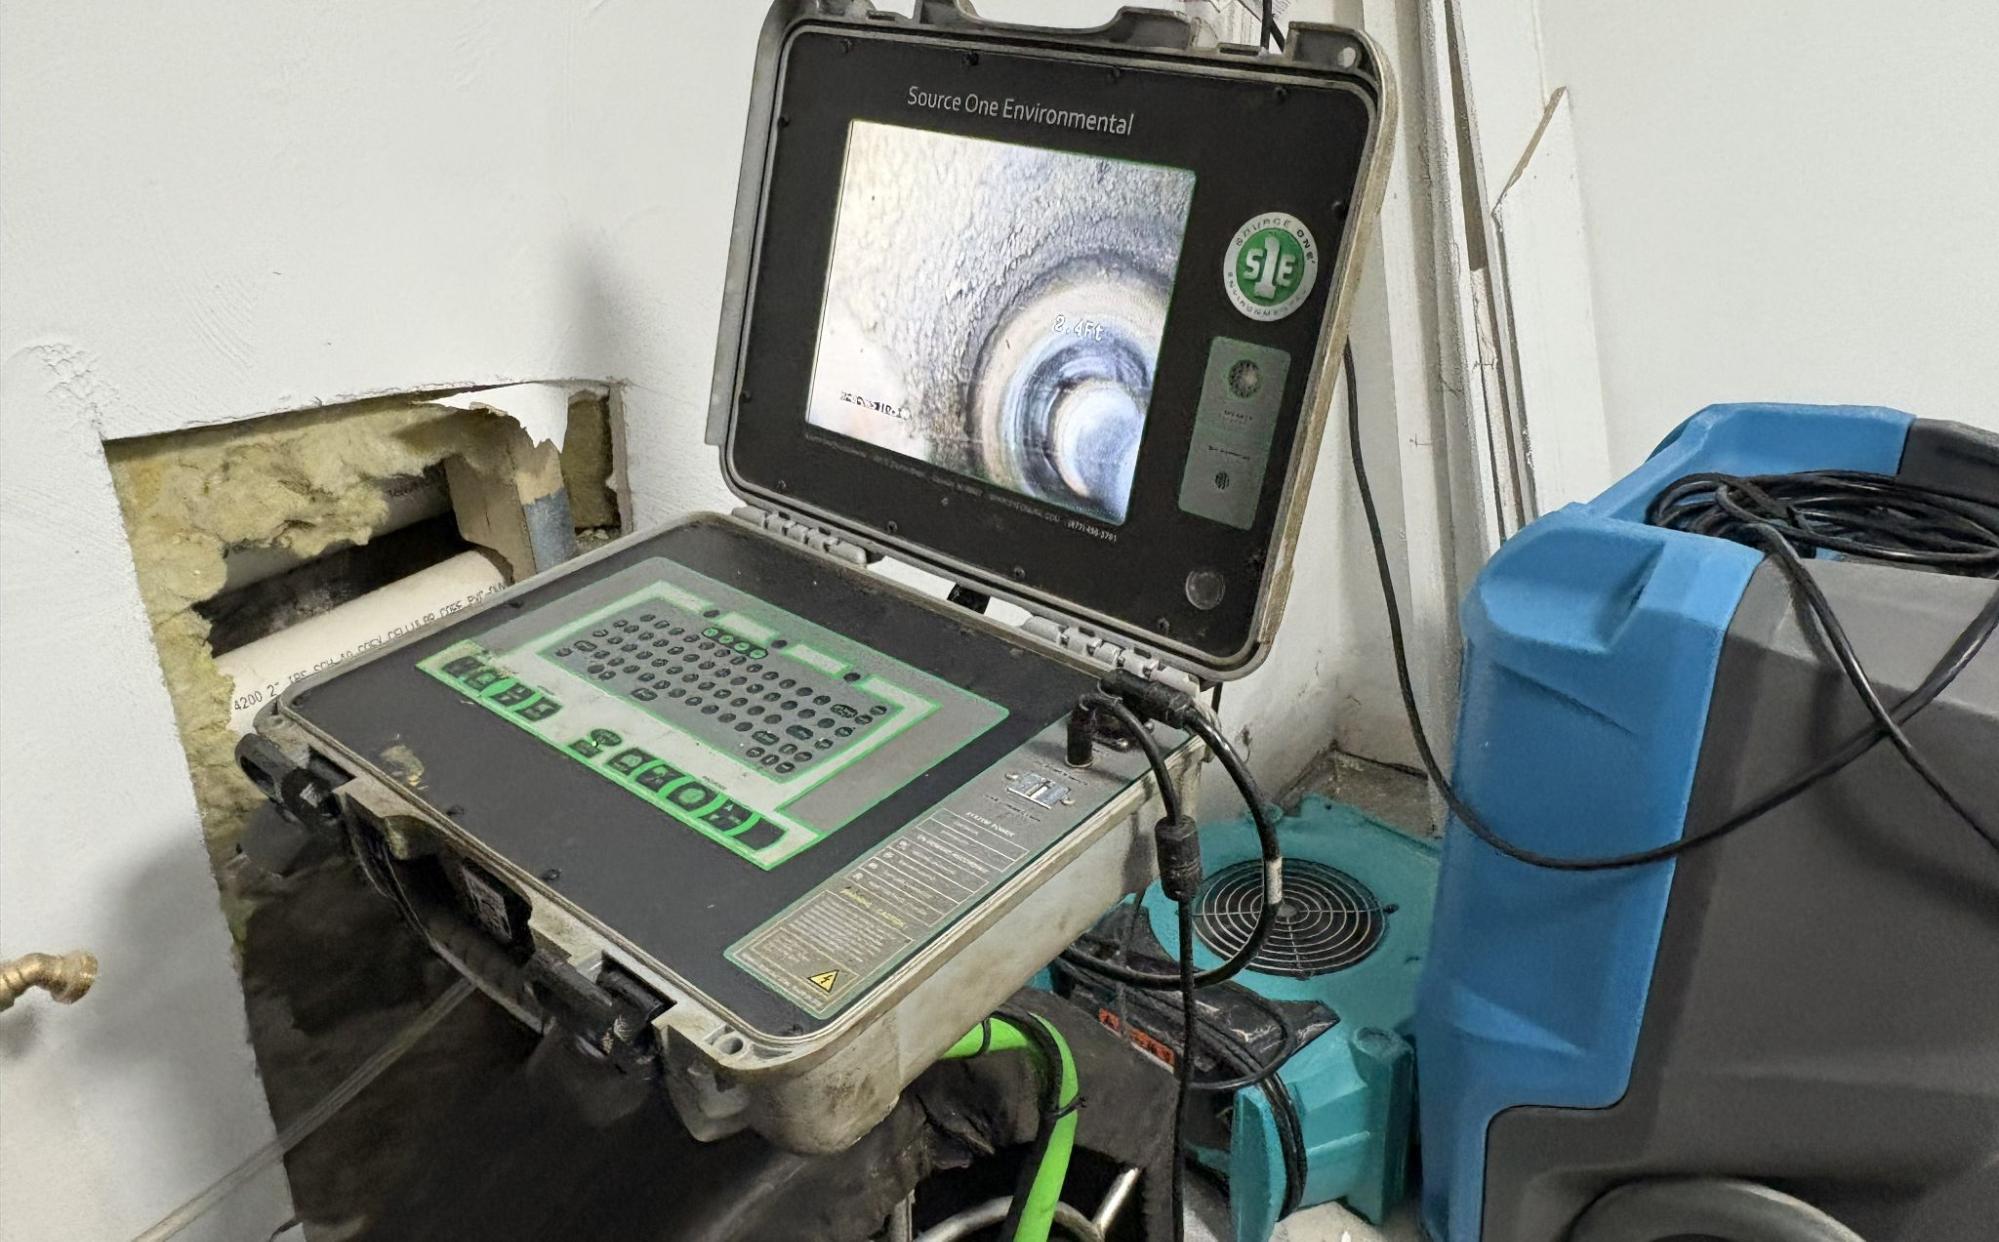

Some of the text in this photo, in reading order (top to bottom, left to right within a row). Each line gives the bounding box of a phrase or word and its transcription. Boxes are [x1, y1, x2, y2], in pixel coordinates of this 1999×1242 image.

[907, 85, 1134, 136] Source One Environmental
[234, 690, 263, 711] 4200
